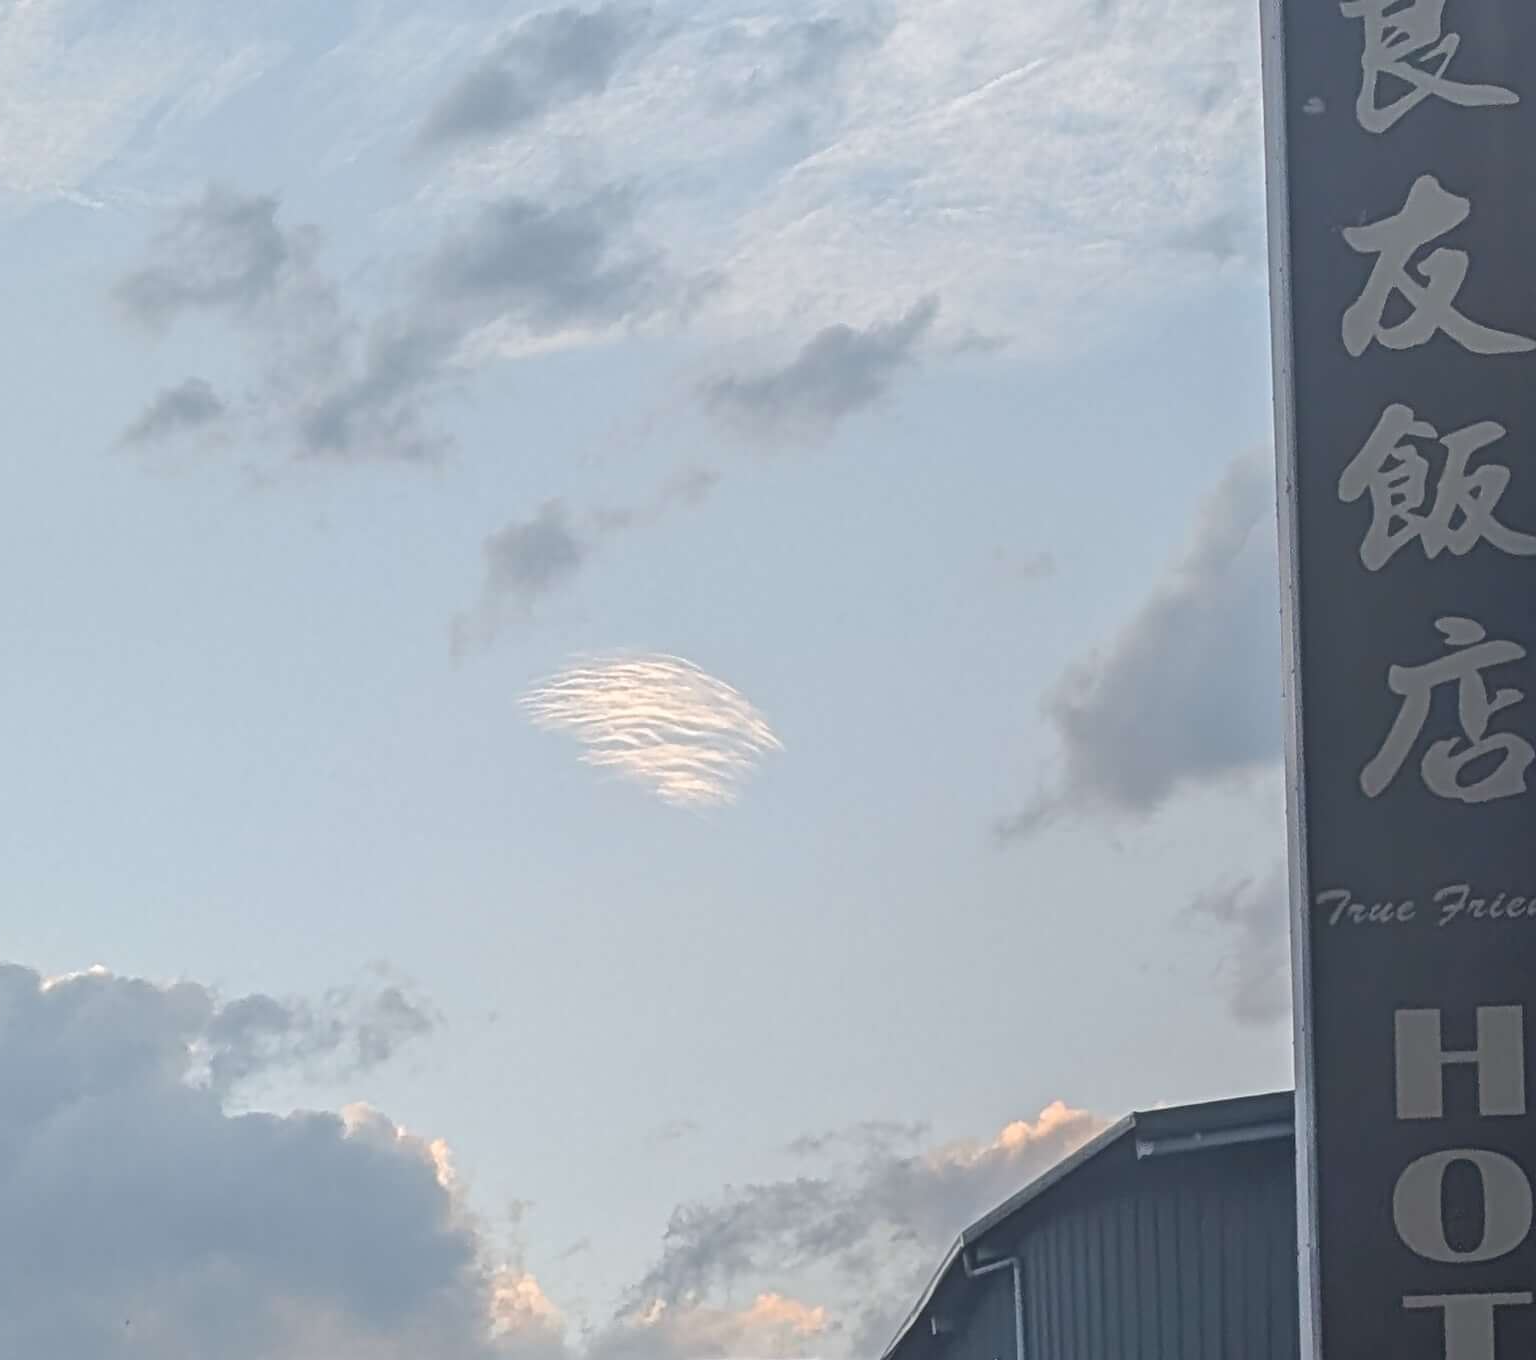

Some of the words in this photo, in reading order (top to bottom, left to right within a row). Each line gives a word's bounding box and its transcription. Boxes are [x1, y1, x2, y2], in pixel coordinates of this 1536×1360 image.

[1339, 0, 1536, 803] 良友飯店
[1316, 888, 1416, 926] True
